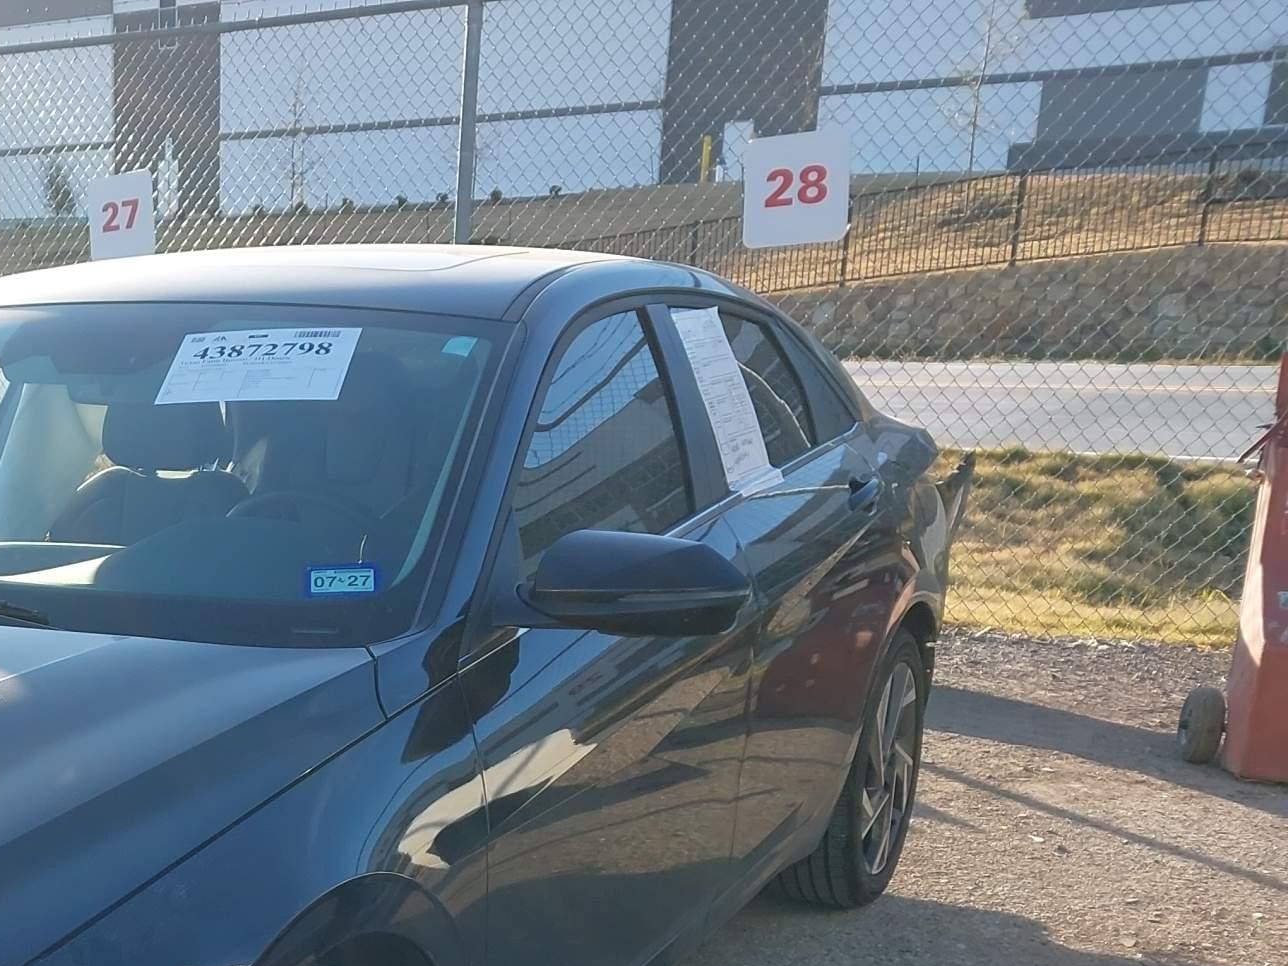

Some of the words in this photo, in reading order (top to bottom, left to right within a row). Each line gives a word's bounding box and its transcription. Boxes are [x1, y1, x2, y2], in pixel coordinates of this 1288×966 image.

[764, 164, 828, 209] 28
[102, 198, 140, 233] 27
[192, 341, 333, 360] 43872798
[313, 576, 337, 588] 07
[347, 575, 371, 587] 27
